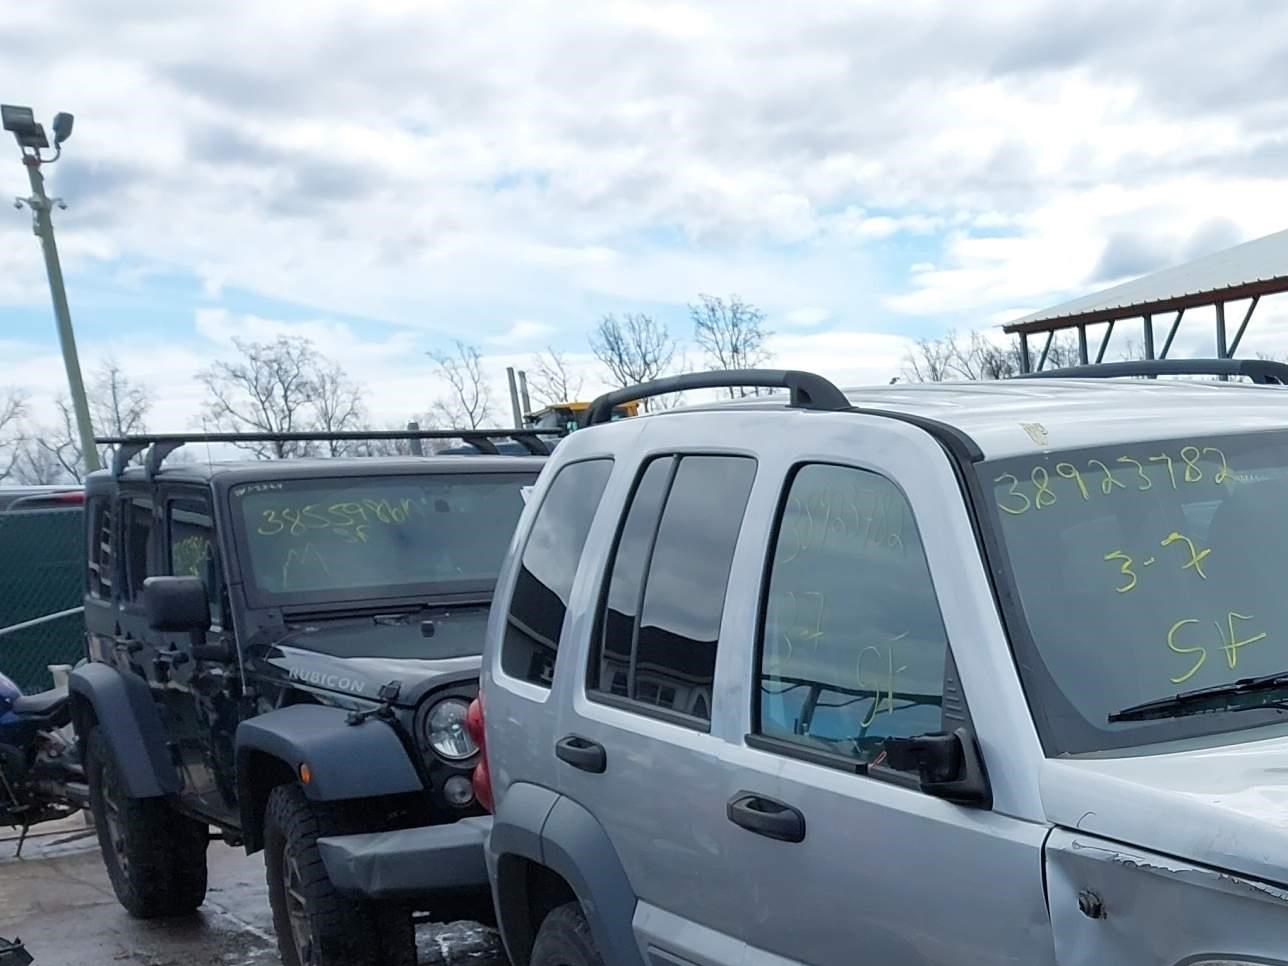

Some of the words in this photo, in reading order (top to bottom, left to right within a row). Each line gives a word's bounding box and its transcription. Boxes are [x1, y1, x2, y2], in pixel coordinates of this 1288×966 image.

[994, 446, 1229, 515] 38923782
[1104, 533, 1212, 593] 3-7
[288, 664, 366, 693] RUBICON
[1167, 612, 1267, 684] SF
